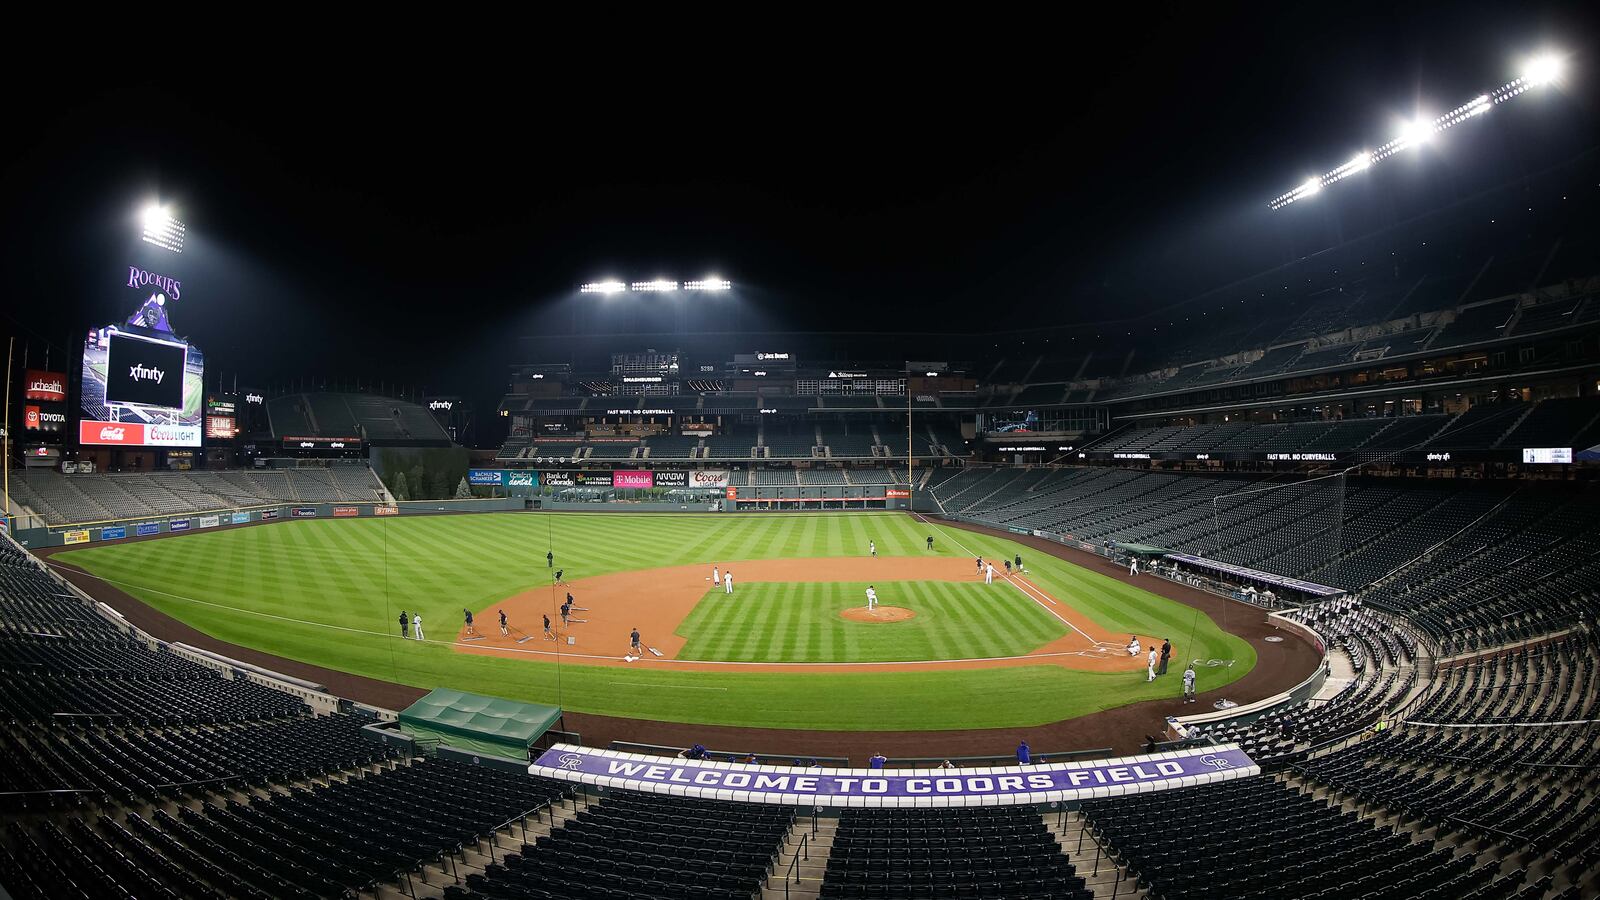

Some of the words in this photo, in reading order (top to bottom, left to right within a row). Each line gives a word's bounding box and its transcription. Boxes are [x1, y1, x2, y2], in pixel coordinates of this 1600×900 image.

[127, 266, 181, 301] ROCKIES
[129, 363, 165, 384] xfinity
[31, 379, 62, 391] uchealth
[245, 393, 264, 404] xfinity
[429, 401, 452, 411] xfinity
[40, 413, 66, 423] TOYOTA
[150, 426, 174, 440] Coors
[174, 432, 194, 441] LIGHT
[1301, 453, 1337, 461] CURVEBALLS.
[508, 477, 532, 486] dental
[624, 474, 651, 484] Mobile
[694, 471, 722, 482] Coors
[607, 760, 827, 793] WELCOME
[834, 777, 889, 794] TO
[905, 775, 1056, 795] COORS
[1070, 760, 1186, 786] FIELD
